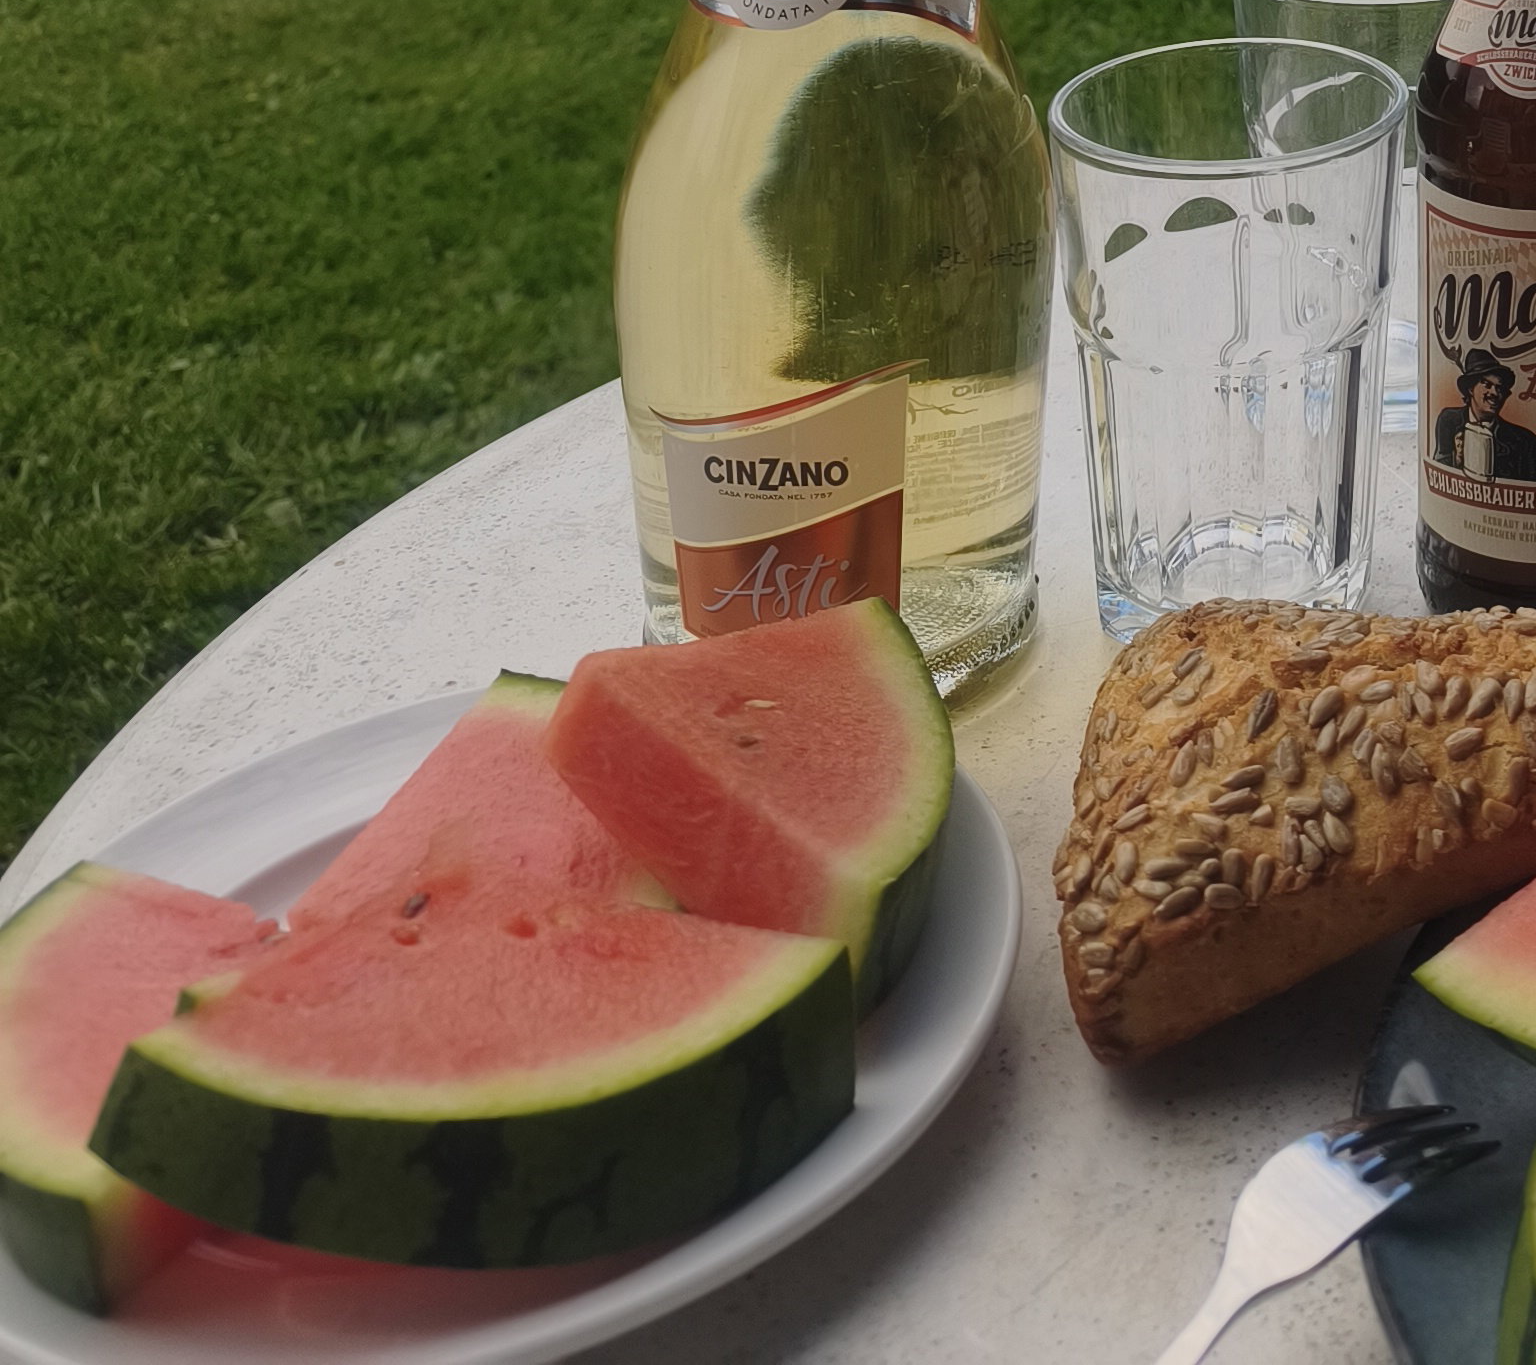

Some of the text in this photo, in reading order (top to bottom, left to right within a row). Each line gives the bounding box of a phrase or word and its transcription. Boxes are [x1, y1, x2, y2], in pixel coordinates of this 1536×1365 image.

[1447, 247, 1513, 267] ORIGINAL
[704, 456, 849, 491] CINZANO
[718, 489, 741, 498] CASA
[745, 492, 784, 500] FONDATA
[701, 544, 869, 621] Asti
